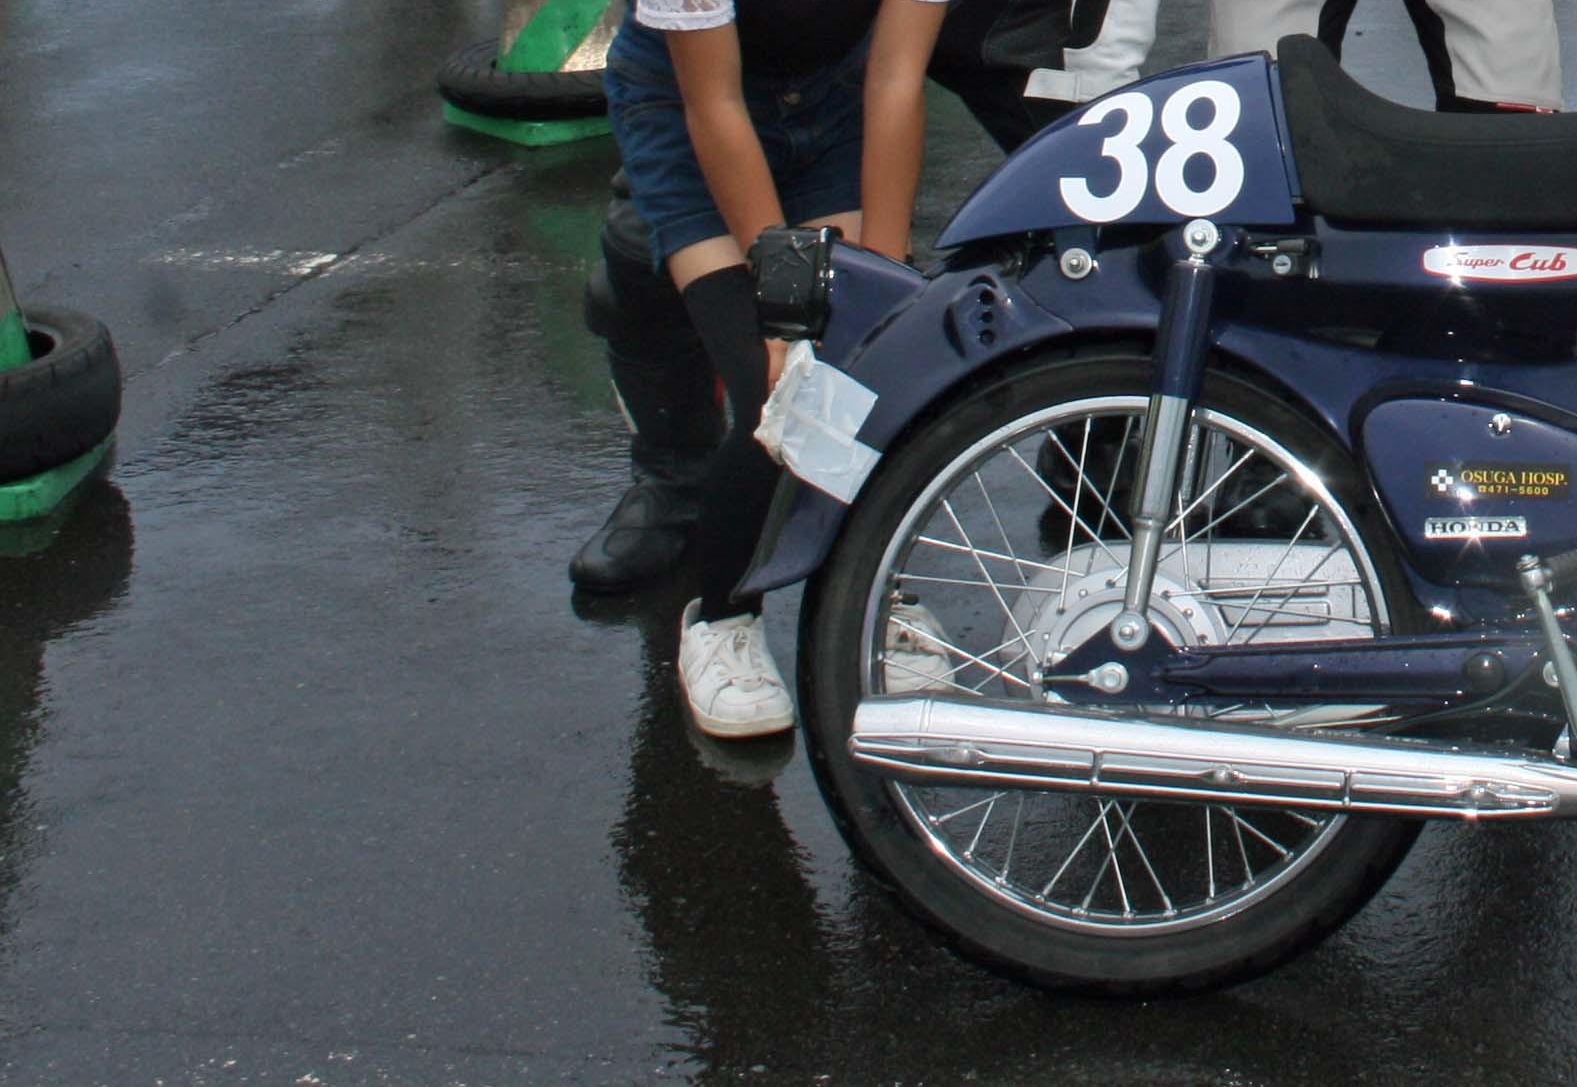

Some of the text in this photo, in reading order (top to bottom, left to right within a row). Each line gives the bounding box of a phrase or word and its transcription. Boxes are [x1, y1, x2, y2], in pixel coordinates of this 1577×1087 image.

[1059, 80, 1245, 223] 38
[1448, 252, 1567, 271] Super Cub
[1460, 470, 1568, 486] OSUGA HOSP.
[1430, 521, 1519, 533] HONDA
